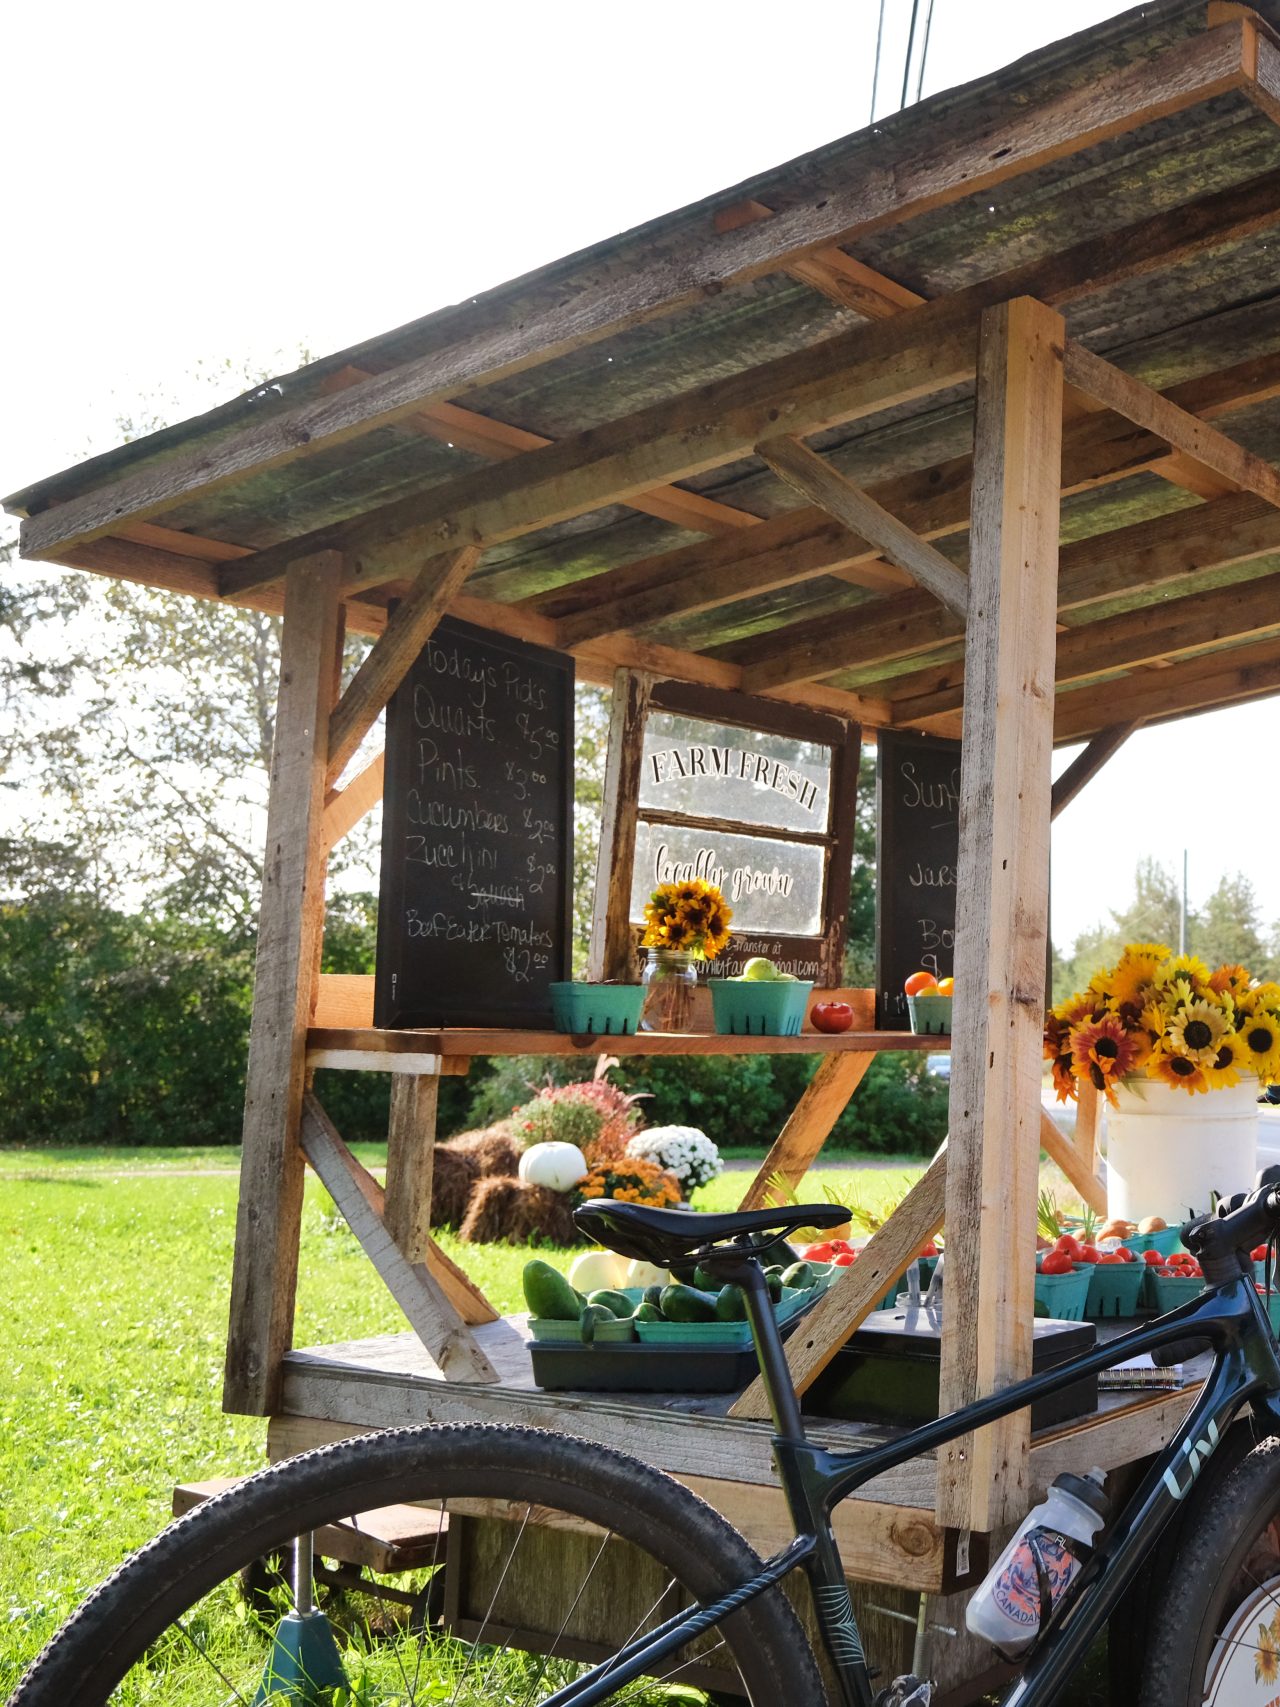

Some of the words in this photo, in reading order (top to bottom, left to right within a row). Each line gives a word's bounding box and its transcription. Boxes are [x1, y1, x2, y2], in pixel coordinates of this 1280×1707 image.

[414, 684, 496, 741] Quarts
[649, 746, 731, 785] FARM
[736, 750, 819, 812] FRESH
[901, 762, 960, 811] Sunf
[407, 789, 508, 833] Cucumbers
[405, 832, 497, 872] Zucchini
[655, 845, 728, 890] locally
[732, 865, 793, 901] grown
